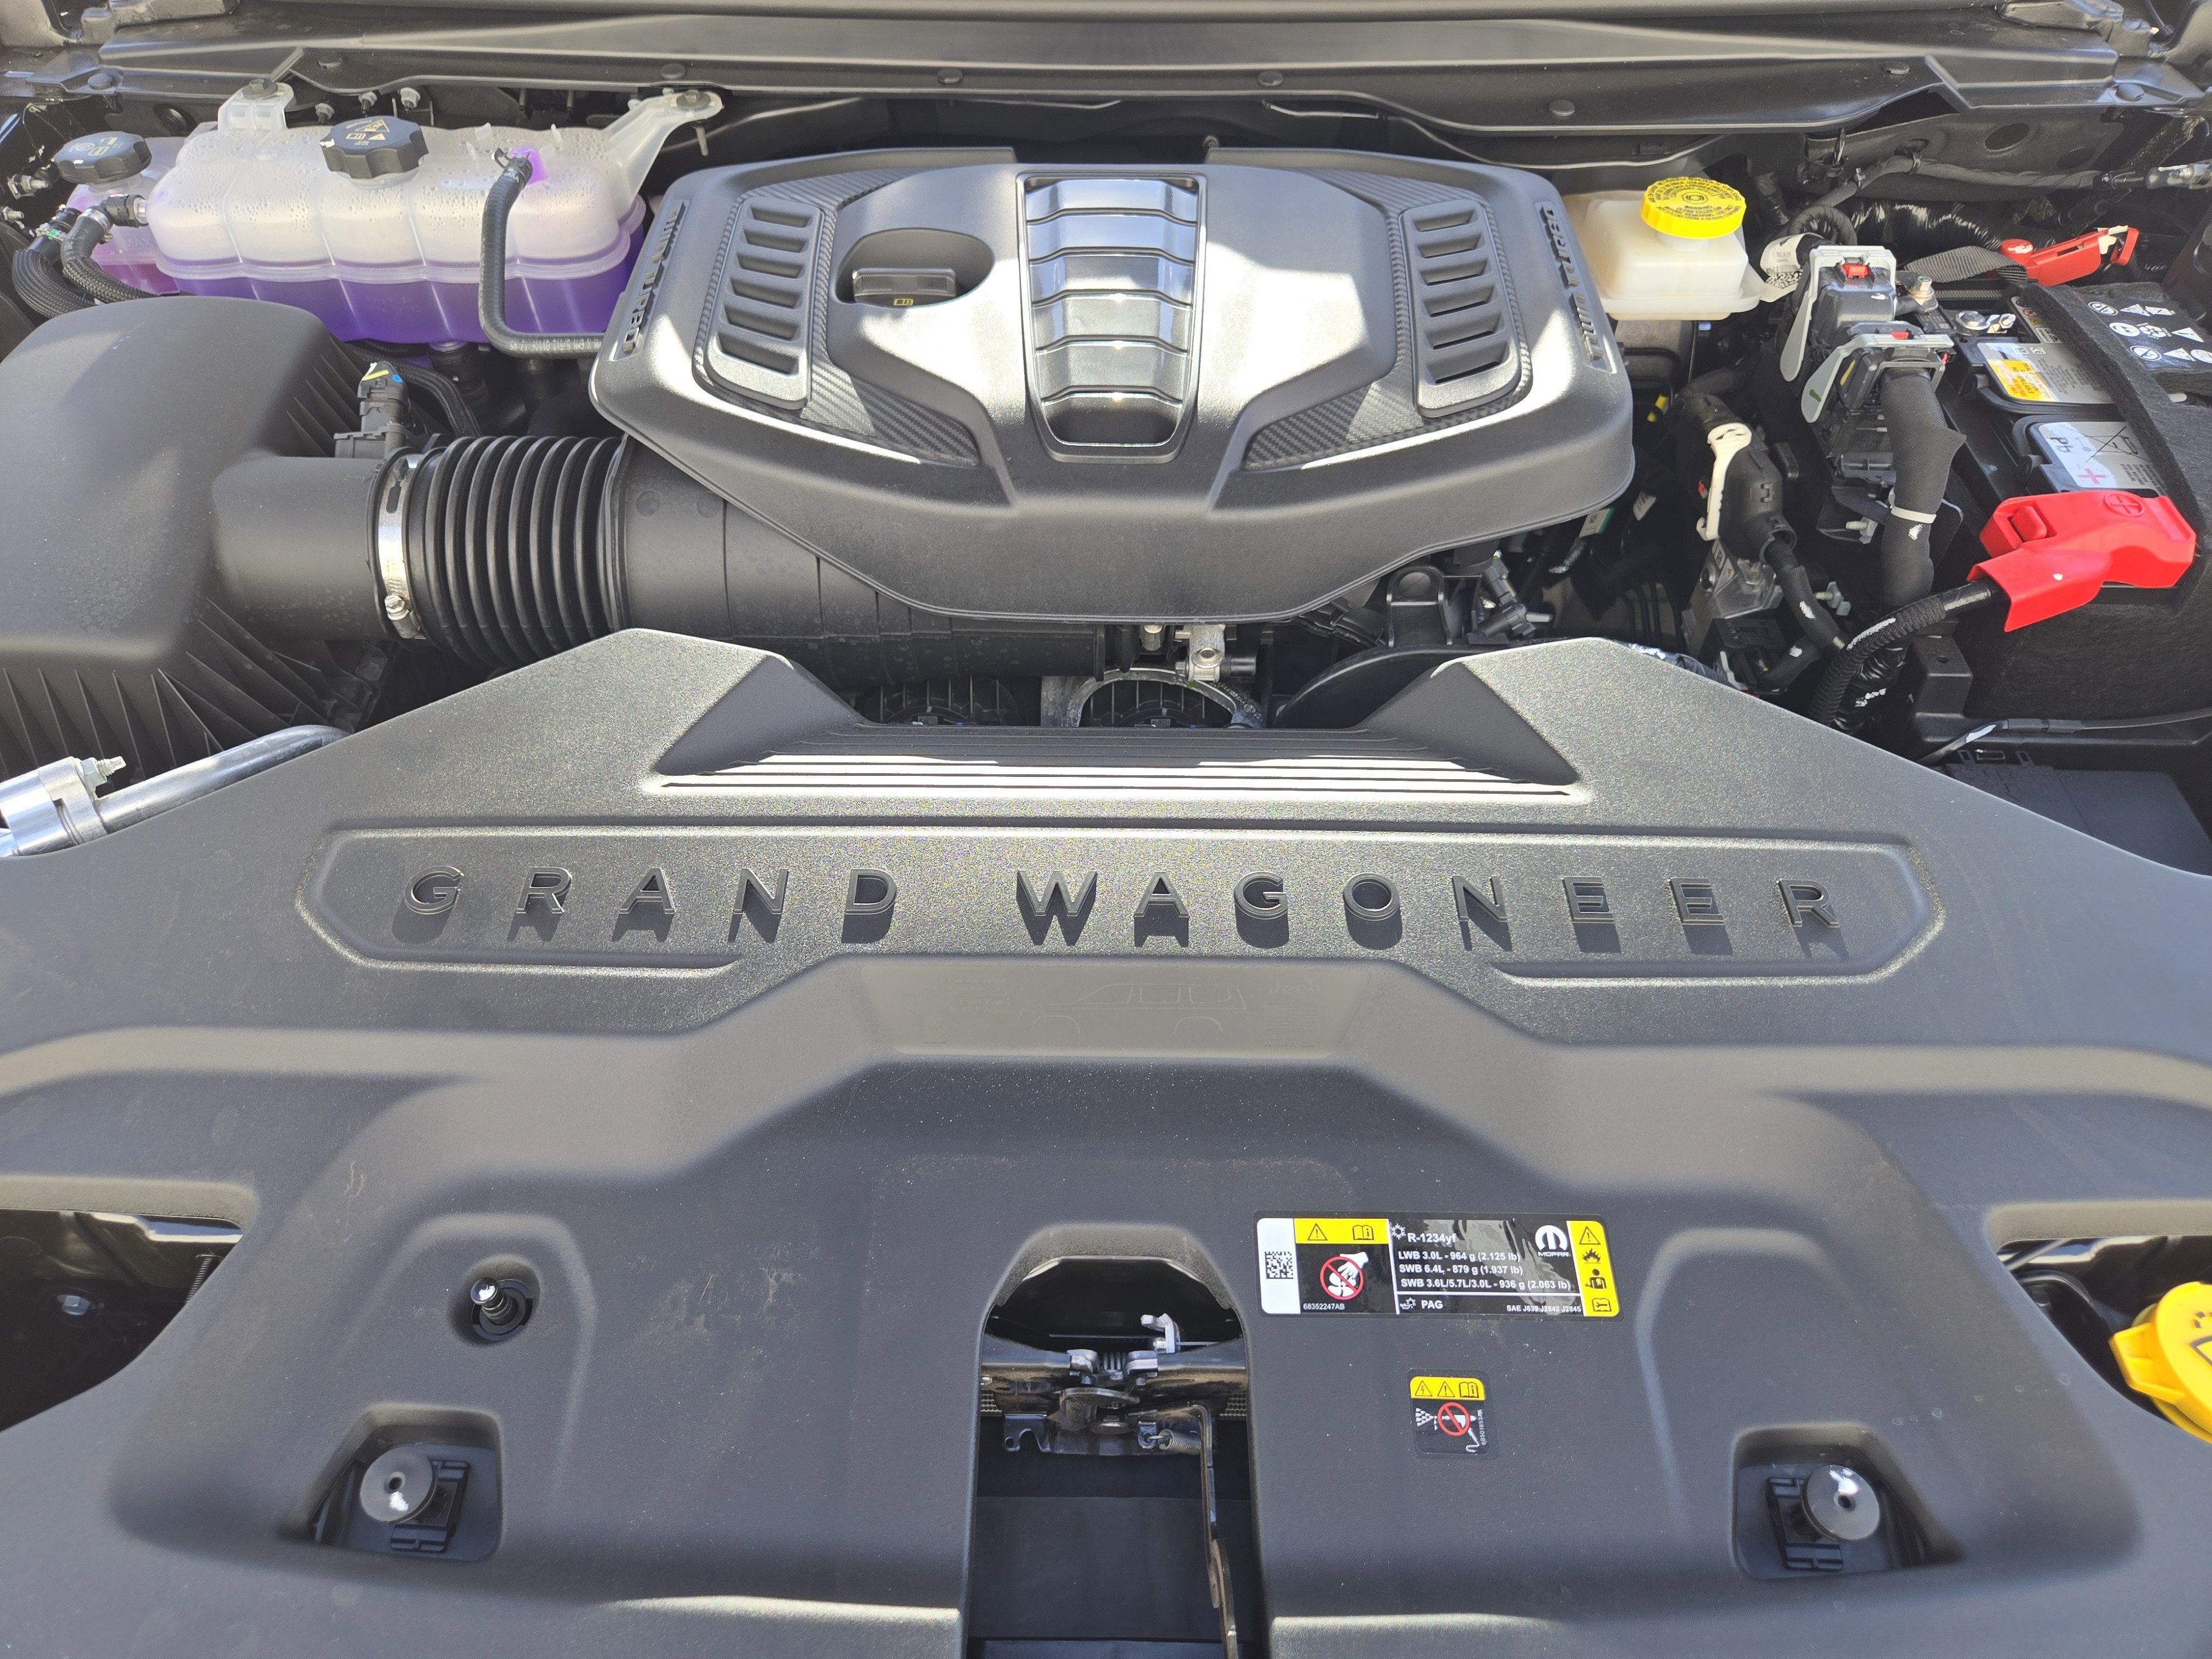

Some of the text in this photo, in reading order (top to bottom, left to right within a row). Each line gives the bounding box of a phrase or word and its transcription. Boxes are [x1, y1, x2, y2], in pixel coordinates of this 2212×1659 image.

[1541, 205, 1579, 288] TURBO
[622, 261, 663, 351] TURBO
[404, 865, 1840, 928] GRAND WAGONEER
[1407, 1233, 1457, 1244] R-1234yf
[1398, 1251, 1421, 1260] LWB
[1422, 1251, 1442, 1260] 3.0L
[1450, 1252, 1467, 1260] 964
[1469, 1254, 1475, 1262] g
[1478, 1252, 1507, 1262] (2.125
[1508, 1252, 1521, 1262] lb)
[1399, 1264, 1422, 1273] SWB
[1452, 1265, 1469, 1273] 879
[1472, 1267, 1478, 1275] g
[1480, 1265, 1507, 1276] (1.937
[1510, 1266, 1523, 1276] lb)
[1401, 1279, 1425, 1288] SWB
[1426, 1279, 1492, 1288] 3.6L/5.7L/3.0L
[1499, 1280, 1516, 1288] 936
[1519, 1282, 1525, 1290] g
[1527, 1280, 1556, 1290] (2.063
[1558, 1280, 1571, 1291] lb)
[1421, 1300, 1444, 1310] PAG
